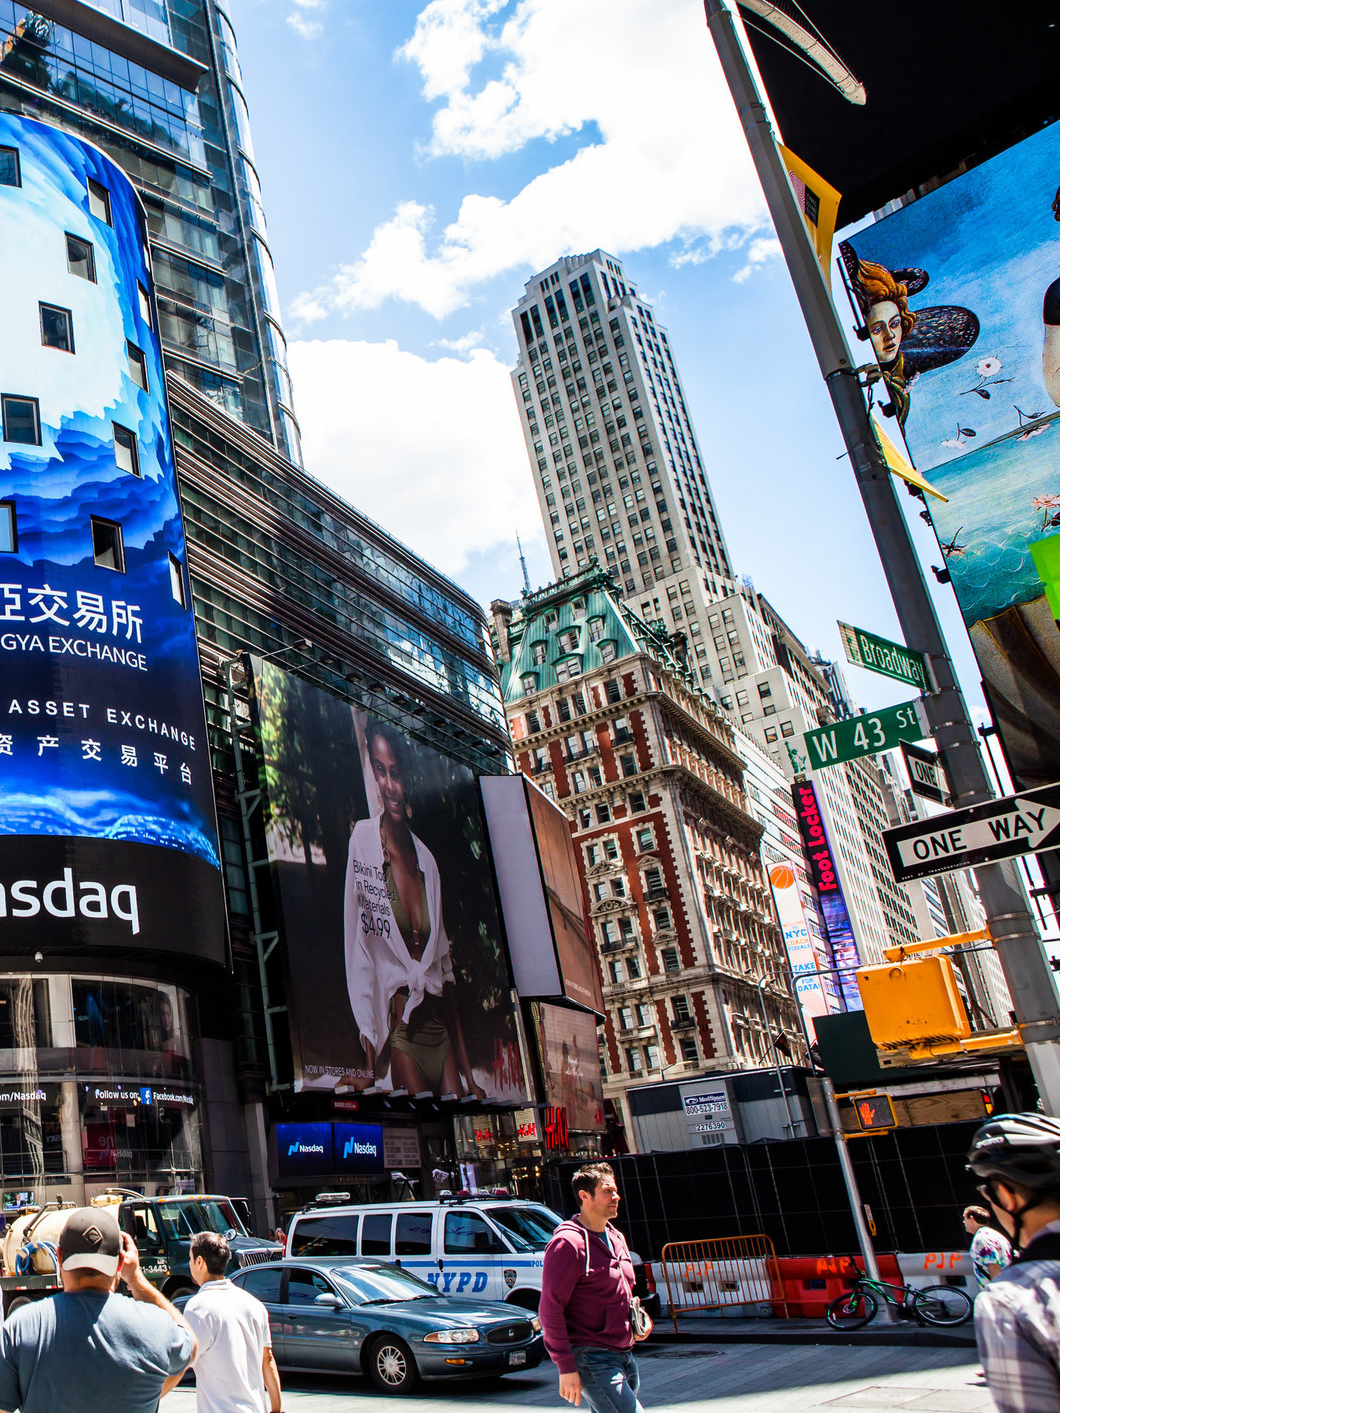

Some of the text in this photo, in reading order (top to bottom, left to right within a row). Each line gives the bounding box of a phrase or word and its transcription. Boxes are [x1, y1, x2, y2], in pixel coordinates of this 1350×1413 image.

[49, 637, 148, 672] EXCHANGE
[859, 634, 927, 691] Broadway
[8, 700, 90, 719] ASSET
[107, 709, 196, 751] EXCHANGE
[812, 707, 916, 762] W 43 St
[914, 760, 937, 787] ONE
[799, 787, 837, 891] Foot Locker
[912, 808, 1045, 860] ONE WAY
[353, 860, 373, 878] Bikini
[928, 861, 971, 874] TRANSPORTATION
[355, 877, 396, 902] in Recycled
[357, 894, 391, 916] Materials
[361, 911, 391, 939] $4.99
[785, 929, 807, 939] NYC
[787, 938, 810, 946] COACH
[793, 962, 816, 972] TAKE
[304, 1064, 374, 1079] NOW IN STORES AND ONLINE
[95, 1089, 119, 1099] Follow
[120, 1091, 128, 1099] us
[686, 1102, 728, 1115] 800-523-7918
[544, 1106, 569, 1150] H&M
[697, 1121, 725, 1131] 2276390
[299, 1143, 324, 1153] Nasdaq
[354, 1142, 377, 1157] Nasdaq
[427, 1271, 488, 1293] NYPD
